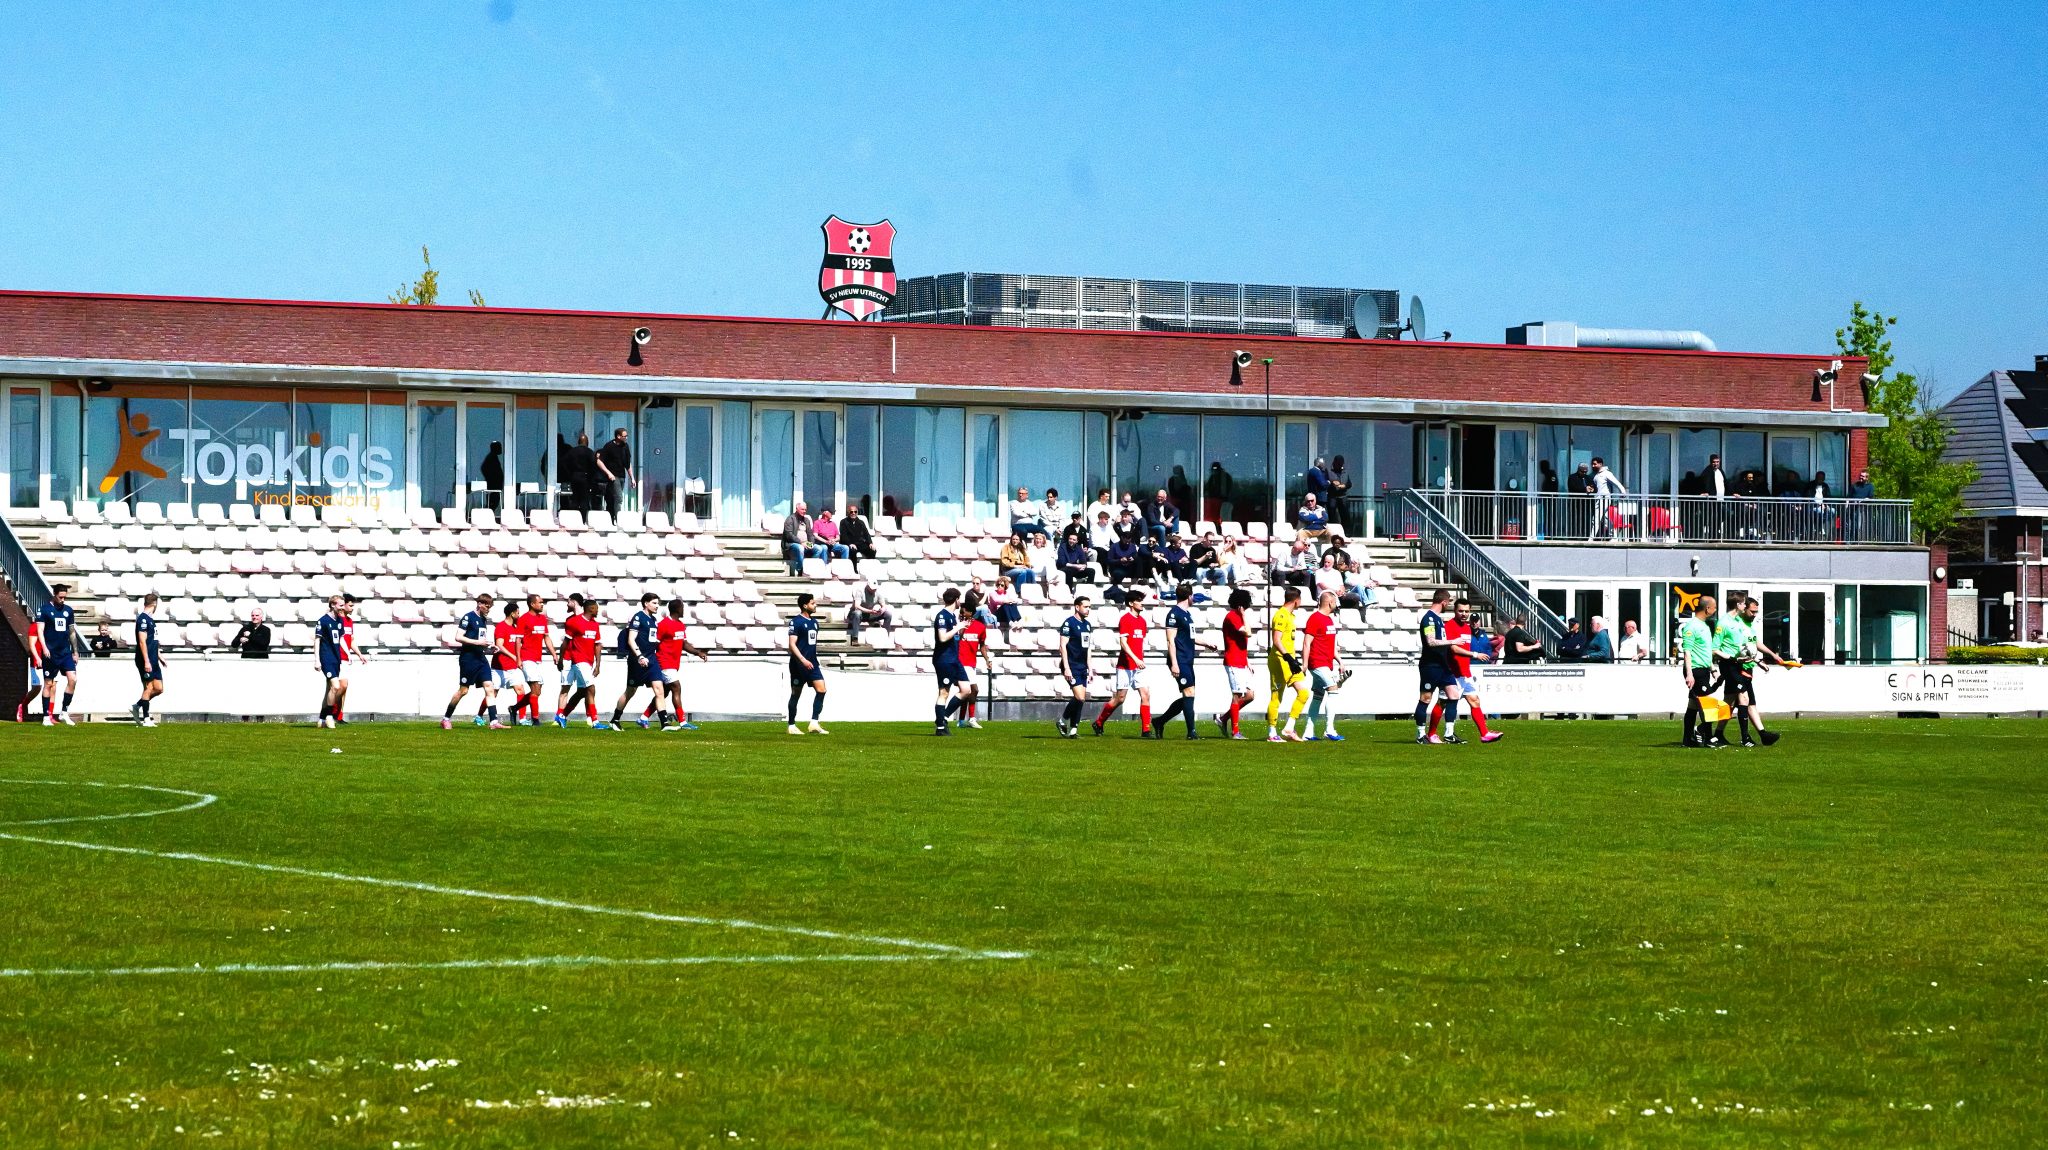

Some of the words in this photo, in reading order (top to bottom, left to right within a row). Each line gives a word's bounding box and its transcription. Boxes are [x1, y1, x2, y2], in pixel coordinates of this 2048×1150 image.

[845, 258, 872, 270] 1995
[829, 292, 838, 301] SV
[838, 288, 860, 297] NIEUW
[860, 289, 890, 303] UTRECHT
[168, 428, 394, 501] Topkids
[1891, 692, 1913, 702] SIGN
[1915, 692, 1921, 702] &
[1923, 692, 1950, 702] PRINT
